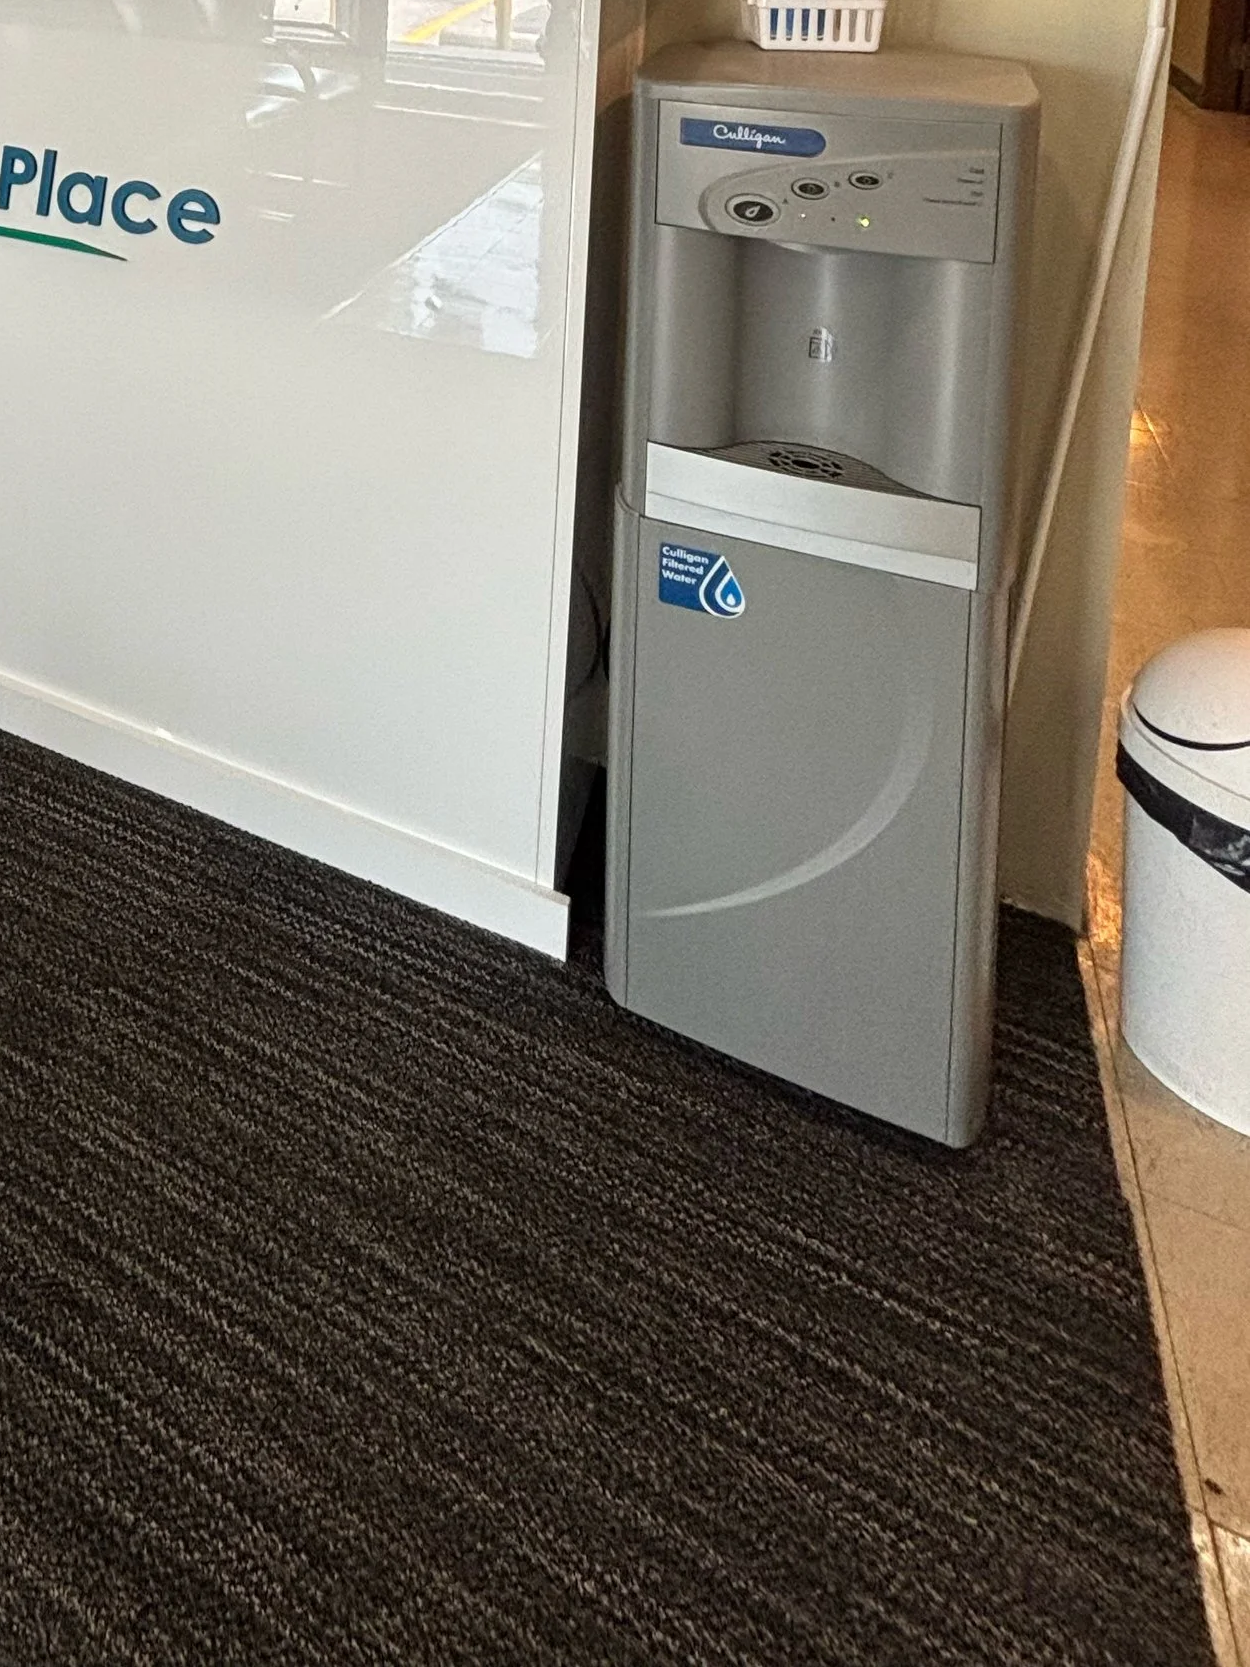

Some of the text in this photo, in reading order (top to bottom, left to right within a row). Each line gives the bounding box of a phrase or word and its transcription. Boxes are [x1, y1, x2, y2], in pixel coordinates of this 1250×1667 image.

[713, 124, 786, 149] Culligan
[662, 546, 709, 564] Culligan
[662, 557, 704, 575] Filtered
[662, 569, 697, 585] Water
